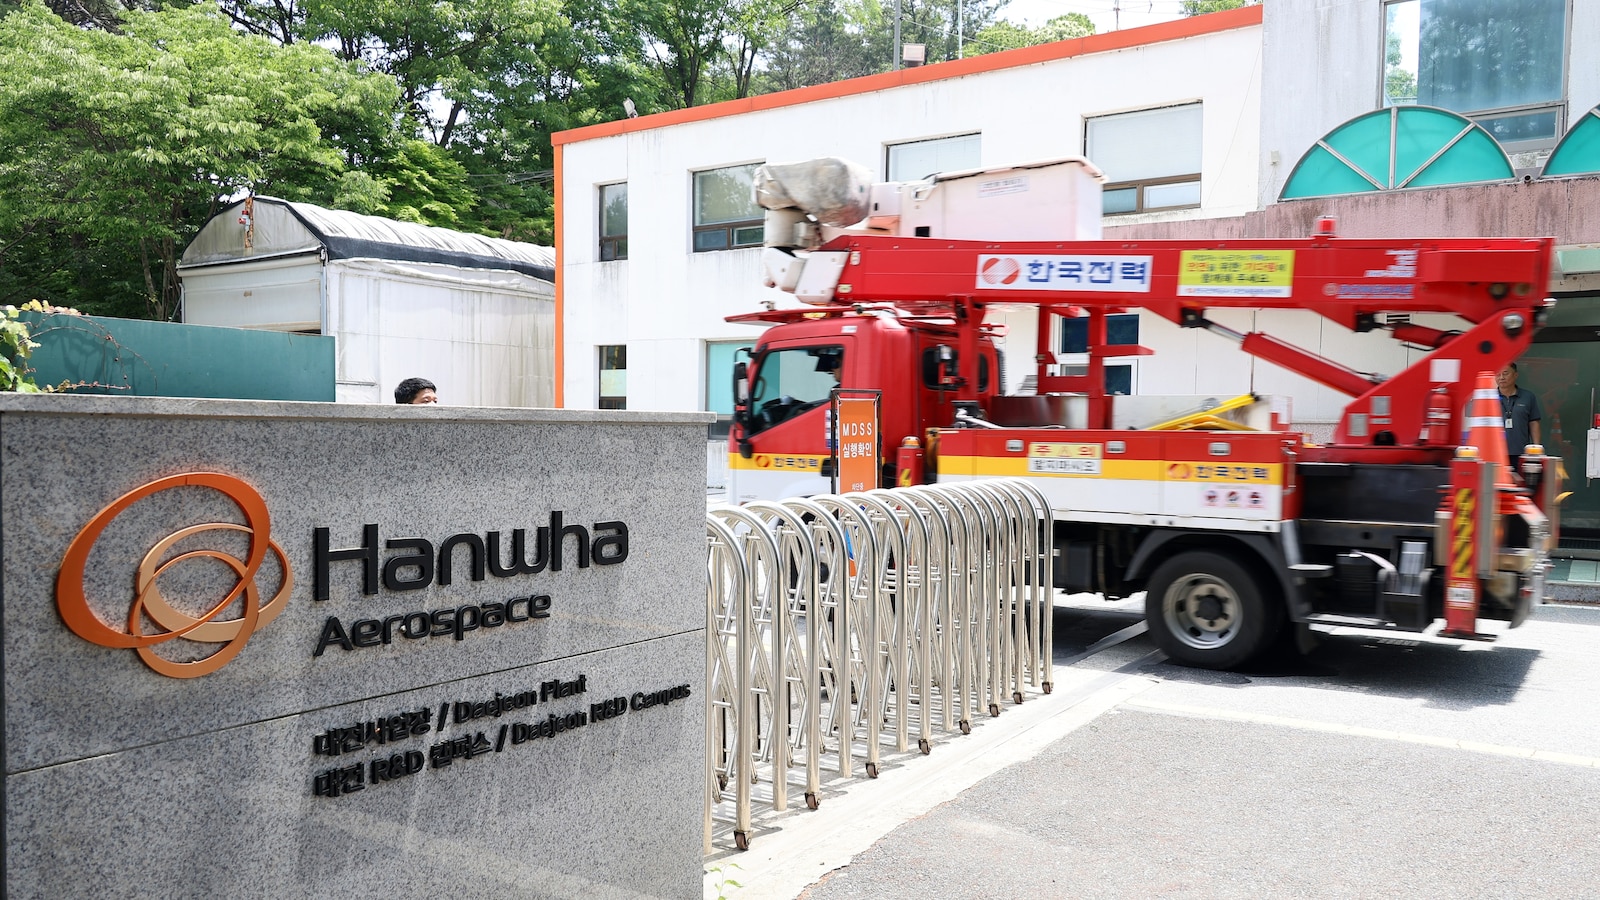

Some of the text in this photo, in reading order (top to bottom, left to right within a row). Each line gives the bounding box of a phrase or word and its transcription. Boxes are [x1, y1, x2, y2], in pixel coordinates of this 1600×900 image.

[1026, 260, 1148, 285] 한국전력
[842, 422, 873, 437] MDSS
[842, 442, 872, 458] 실행확인
[773, 457, 819, 469] 한국전력
[1195, 465, 1269, 480] 한국전력
[314, 511, 629, 601] Hanwha
[313, 594, 551, 657] Aerospace
[313, 707, 433, 756] 대전사업장
[454, 692, 537, 724] Daejeon
[541, 674, 587, 702] Plant
[313, 762, 366, 797] 대전
[370, 750, 425, 784] R&D
[430, 731, 493, 769] 캠퍼스
[512, 711, 588, 745] Daejeon
[590, 696, 628, 723] R&D
[631, 682, 692, 711] Campus
